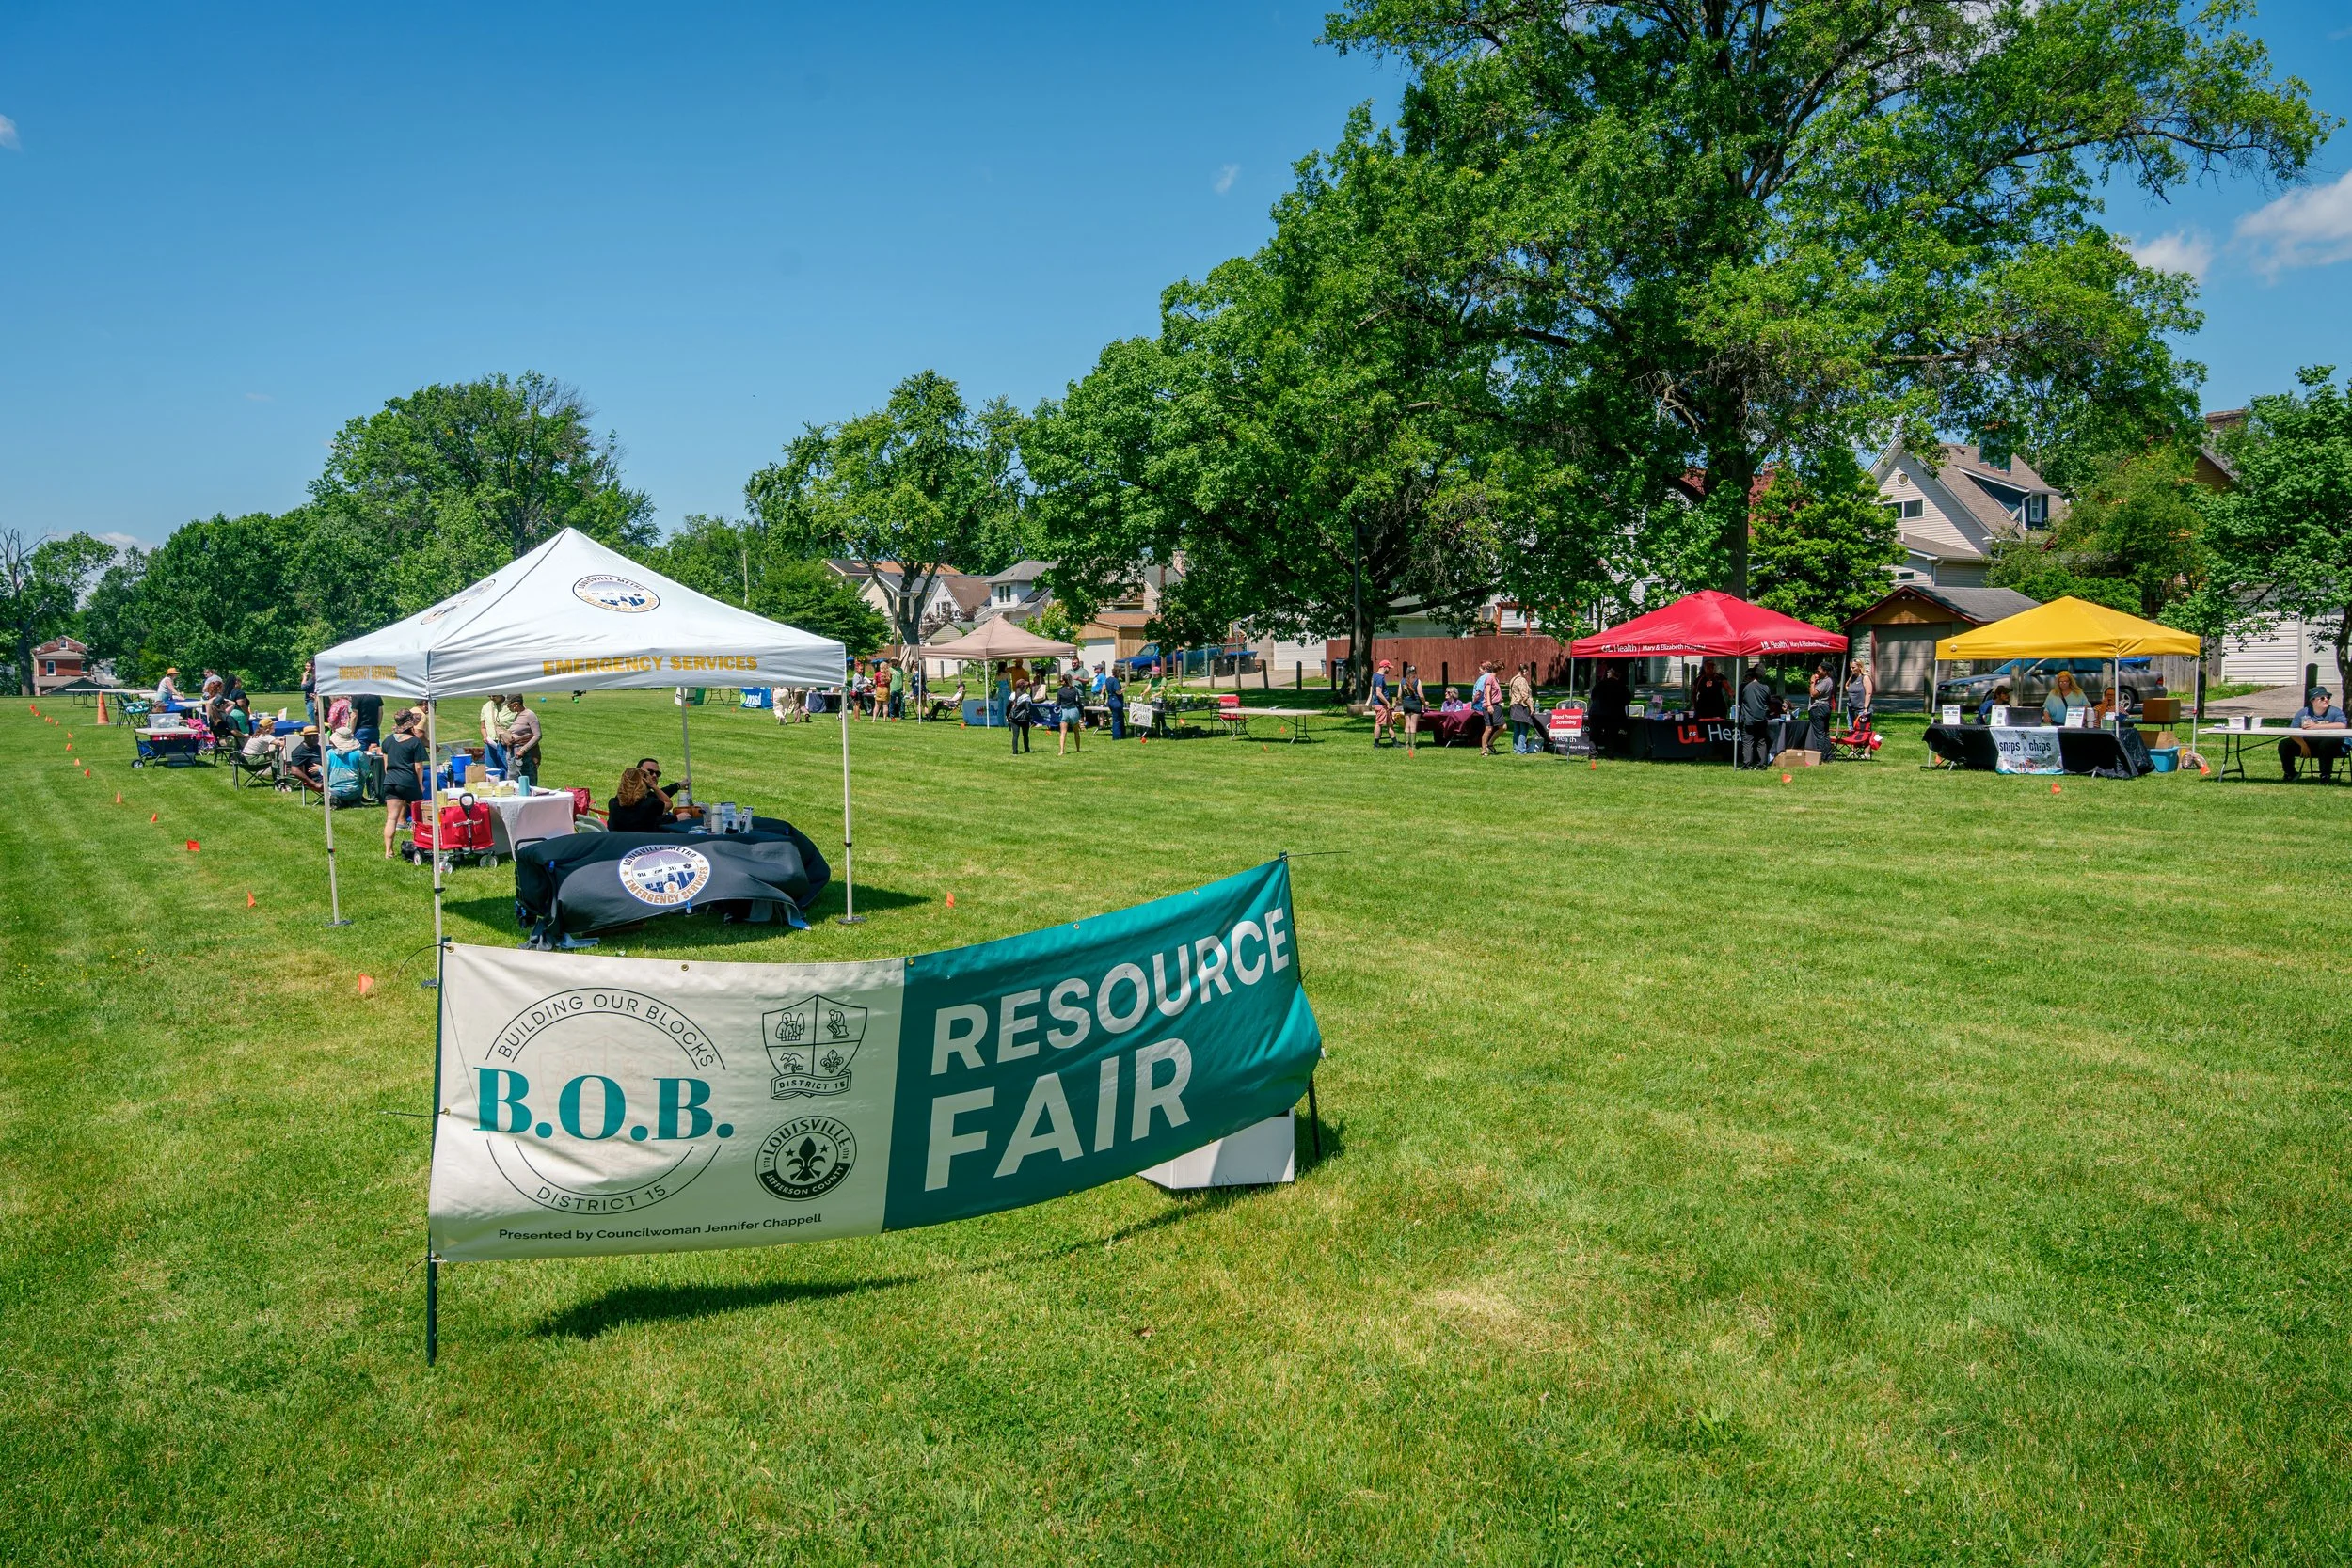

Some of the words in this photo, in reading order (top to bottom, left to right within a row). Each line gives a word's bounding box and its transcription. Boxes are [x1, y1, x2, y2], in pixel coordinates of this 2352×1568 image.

[1613, 643, 1637, 653] Health
[542, 656, 663, 676] EMERGENCY
[670, 656, 758, 671] SERVICES
[745, 691, 762, 705] msd
[1708, 723, 1742, 742] Hea
[1999, 741, 2021, 754] snips
[2028, 739, 2051, 754] chips
[623, 847, 663, 866] LOUISVILLE
[667, 846, 697, 859] METRO
[625, 879, 679, 904] EMERGENCY
[681, 866, 708, 900] SERVICES
[930, 907, 1290, 1076] RESOURCE
[498, 996, 584, 1058] BUILDING
[593, 994, 639, 1012] OUR
[645, 1006, 714, 1068] BLOCKS
[779, 1079, 830, 1090] DISTRICT
[834, 1081, 846, 1089] 15
[473, 1067, 735, 1142] B.O.B.
[924, 1037, 1193, 1192] FAIR
[762, 1118, 852, 1156] LOUISVILLE
[766, 1174, 809, 1196] JEFFERSON
[812, 1165, 845, 1193] COUNTY
[536, 1186, 637, 1212] DISTRICT
[645, 1184, 666, 1202] 15
[499, 1228, 572, 1240] Presented
[576, 1228, 594, 1242] by
[596, 1225, 701, 1239] Councilwoman
[704, 1220, 759, 1234] Jennifer
[763, 1213, 822, 1228] Chappell
